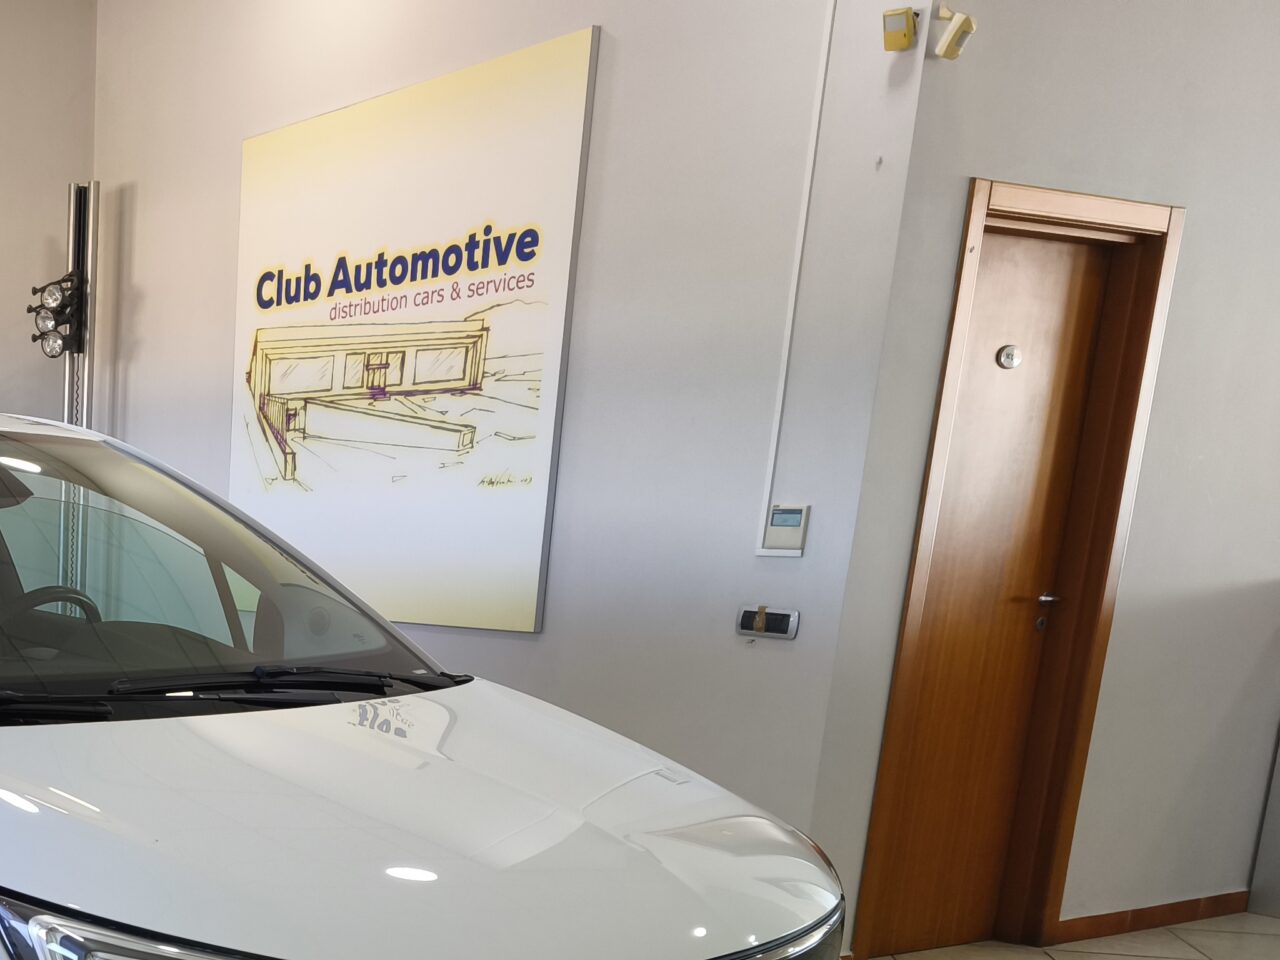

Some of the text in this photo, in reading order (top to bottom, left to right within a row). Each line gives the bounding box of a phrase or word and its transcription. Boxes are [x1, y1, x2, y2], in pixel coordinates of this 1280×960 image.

[256, 225, 540, 309] Club Automotive
[329, 270, 536, 321] distribution cars & services
